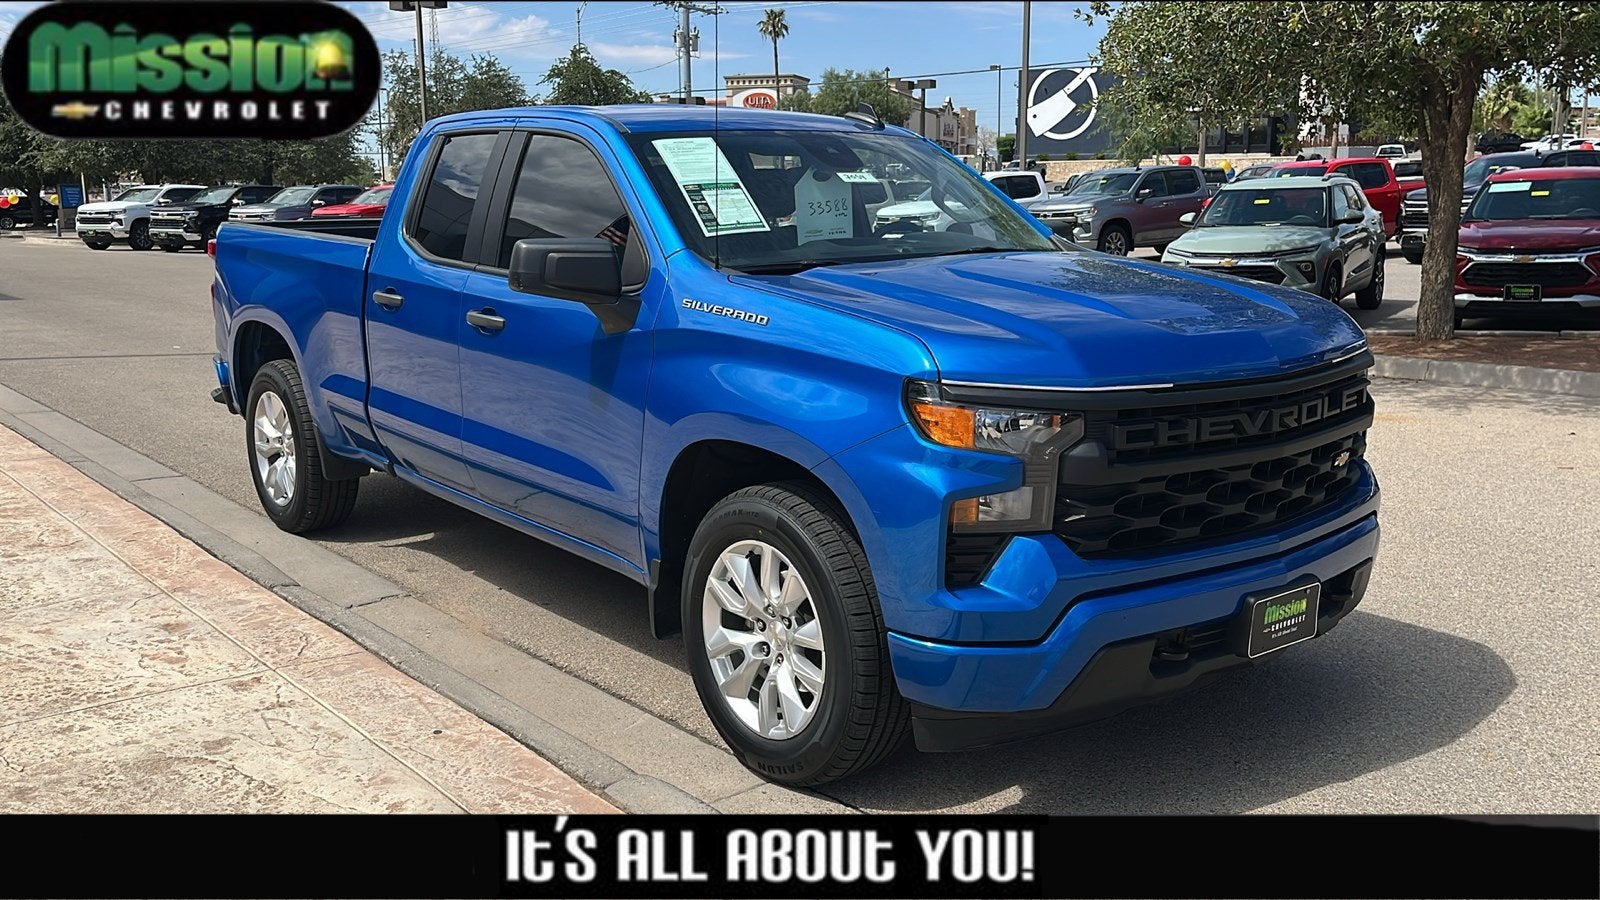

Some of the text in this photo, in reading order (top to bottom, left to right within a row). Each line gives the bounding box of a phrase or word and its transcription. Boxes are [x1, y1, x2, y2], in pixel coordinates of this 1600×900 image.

[808, 197, 848, 216] 33588
[681, 298, 770, 326] SILVERADO
[1112, 386, 1367, 449] CHEVROLET
